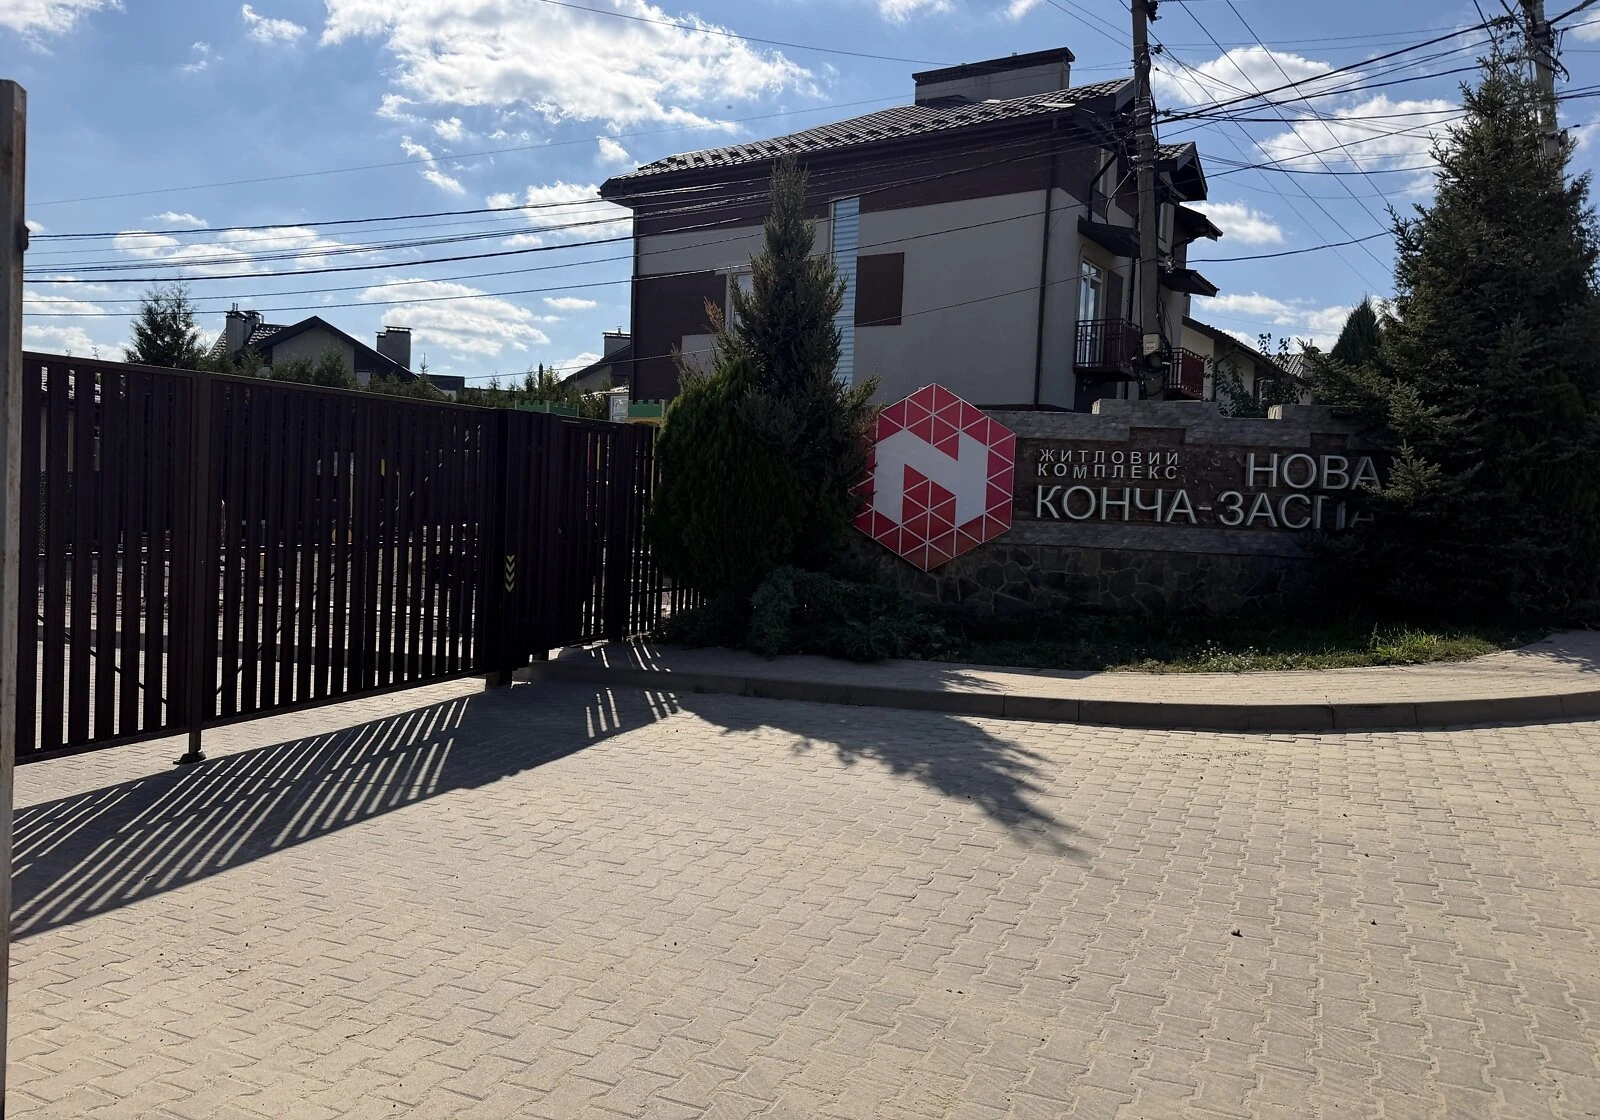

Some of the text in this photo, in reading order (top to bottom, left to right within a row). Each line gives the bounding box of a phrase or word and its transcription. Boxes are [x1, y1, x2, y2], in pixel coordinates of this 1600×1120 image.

[1038, 448, 1179, 466] ЖИТЛОВИЙ
[1037, 463, 1178, 480] КОМПЛЕКС
[1246, 452, 1382, 490] НОВА
